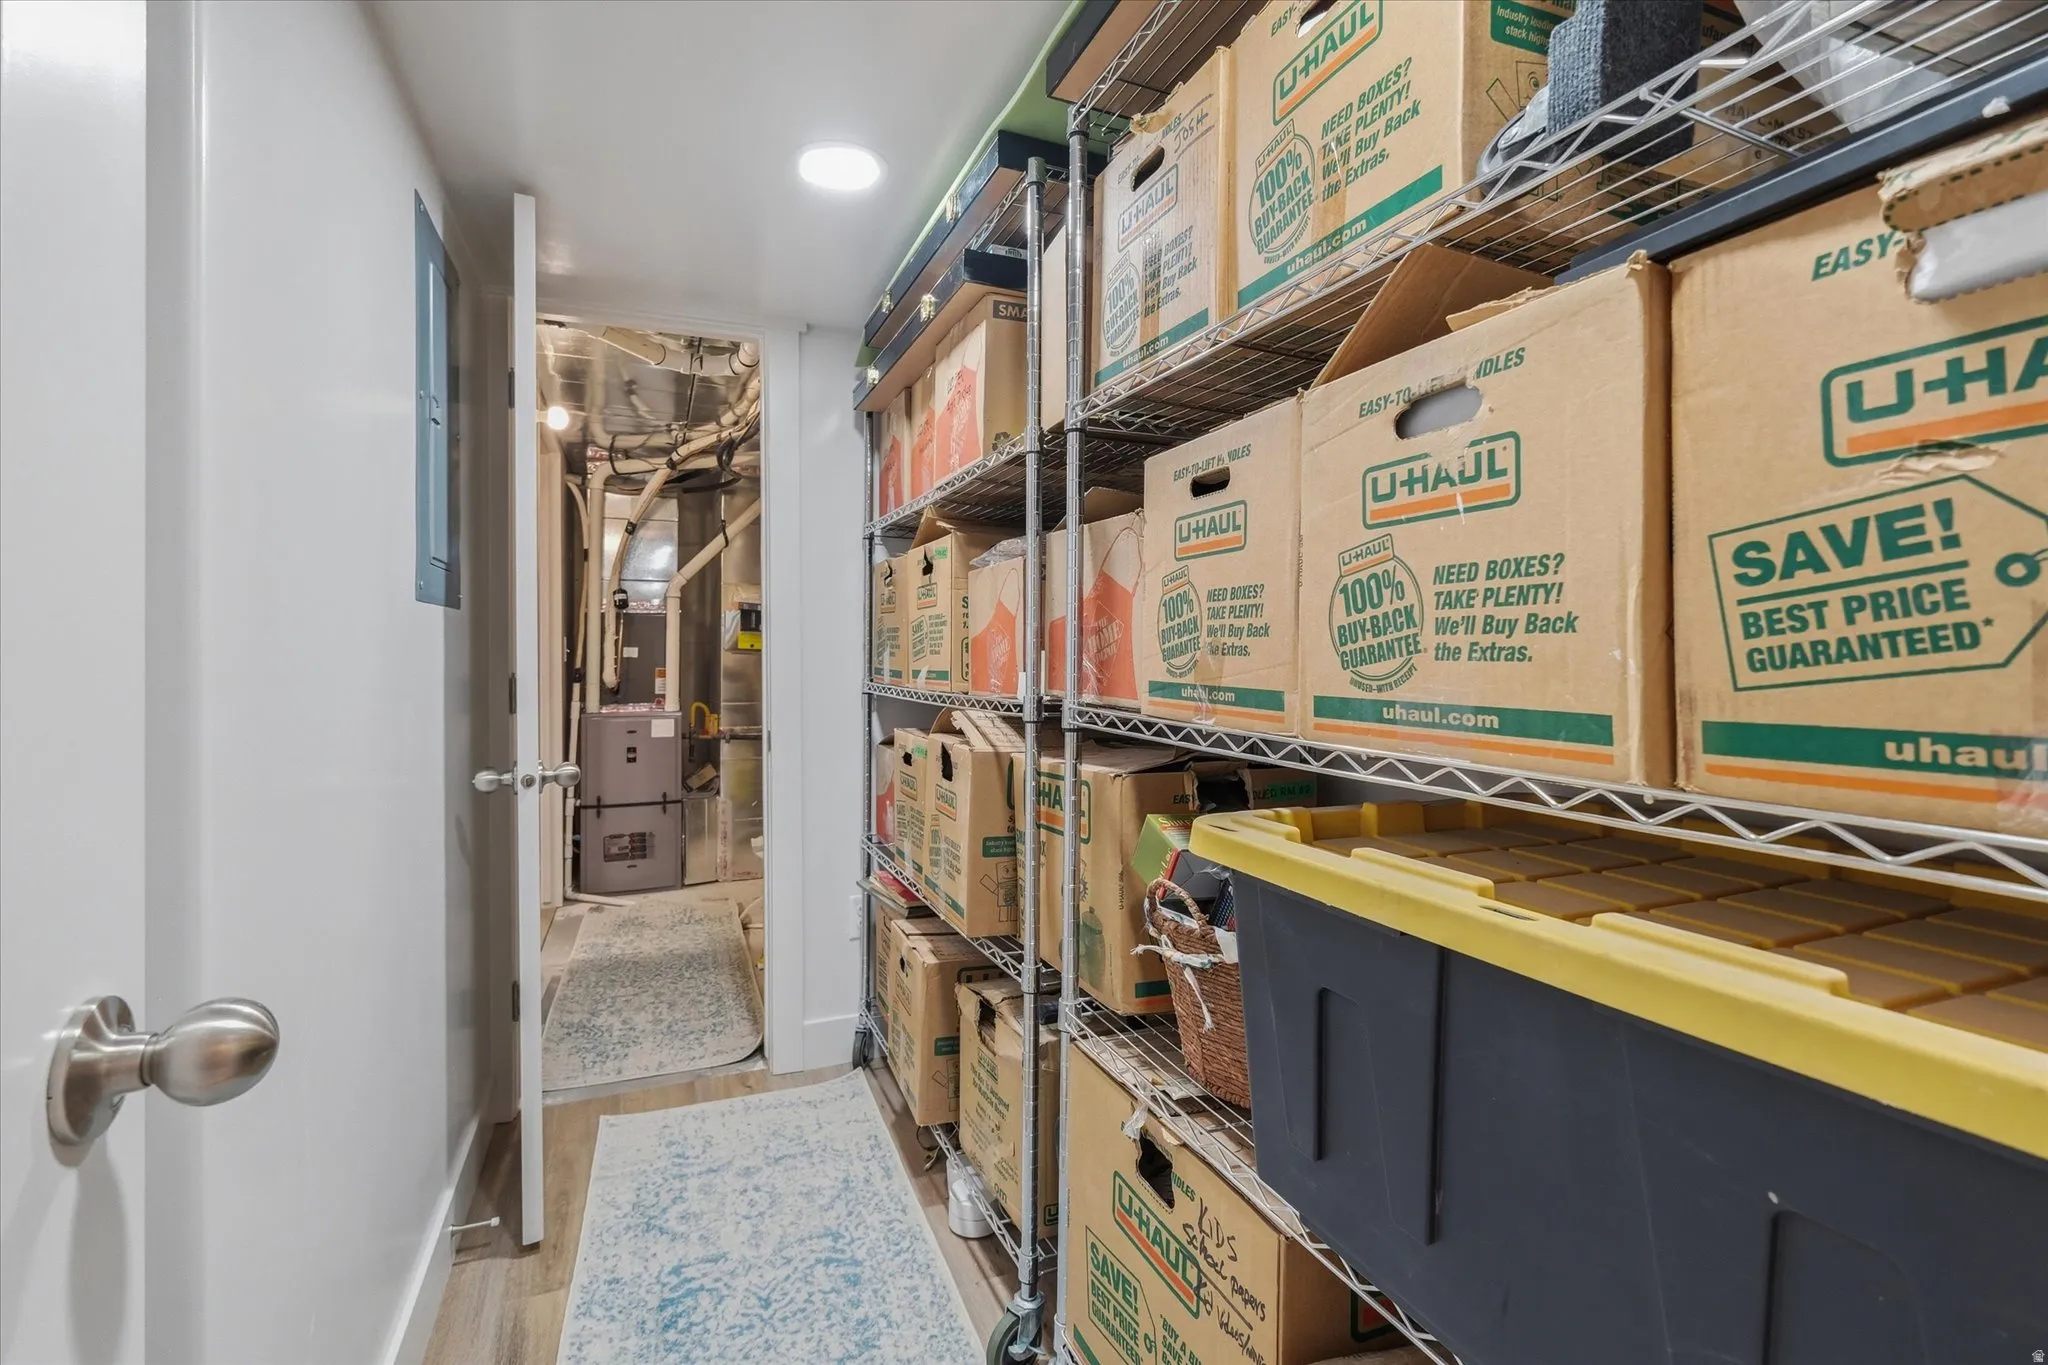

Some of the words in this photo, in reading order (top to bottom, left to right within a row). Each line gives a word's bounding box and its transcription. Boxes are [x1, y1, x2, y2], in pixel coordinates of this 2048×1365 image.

[1496, 5, 1529, 26] Industry
[1505, 25, 1527, 40] stack
[1279, 3, 1375, 100] U-HAUL
[1321, 102, 1353, 140] NEED
[1357, 56, 1412, 112] BOXES?
[1174, 108, 1209, 154] JOSH
[1322, 124, 1351, 160] TAKE
[1355, 80, 1411, 136] PLENTY!
[1354, 129, 1380, 157] Buy
[1384, 99, 1421, 138] Back
[1258, 123, 1292, 168] U-HAUL
[1256, 142, 1302, 209] 100%
[1322, 179, 1341, 202] the
[1345, 148, 1390, 187] Extras.
[1121, 177, 1174, 235] U-HAUL
[1255, 165, 1311, 237] BUY-BACK
[1257, 187, 1313, 255] GUARANTEE
[1162, 242, 1193, 274] PLENTY!
[1164, 225, 1194, 257] BOXES?
[1287, 219, 1367, 275] uhaul.com
[1107, 268, 1135, 313] 100%
[1162, 274, 1176, 290] Buy
[1178, 257, 1197, 280] Back
[999, 304, 1028, 320] SMA
[1105, 290, 1138, 334] BUY-BACK
[1106, 307, 1140, 349] GUARANTEE
[1144, 302, 1155, 318] the
[1123, 335, 1169, 368] uhaul.com
[1473, 346, 1526, 380] NDLES
[1173, 456, 1217, 482] EASY-TO-LIFT
[1371, 447, 1509, 504] U-HAUL
[1178, 510, 1242, 543] U-HAUL
[1732, 497, 1962, 588] SAVE!
[1342, 539, 1390, 567] U-HAUL
[1433, 562, 1479, 585] NEED
[1485, 552, 1565, 581] BOXES?
[1162, 587, 1194, 624] 100%
[1207, 589, 1228, 603] NEED
[1230, 583, 1265, 601] BOXES?
[1338, 564, 1406, 618] 100%
[1434, 589, 1477, 611] TAKE
[1482, 582, 1564, 608] PLENTY!
[1739, 600, 1829, 641] BEST
[1841, 577, 1971, 626] PRICE
[1161, 615, 1199, 645] BUY-BACK
[1207, 606, 1226, 620] TAKE
[1228, 603, 1264, 619] PLENTY!
[1337, 603, 1418, 647] BUY-BACK
[1434, 615, 1476, 636] We'll
[1482, 614, 1519, 639] Buy
[1525, 611, 1579, 634] Back
[1162, 635, 1201, 662] GUARANTEE
[1207, 623, 1226, 638] We'll
[1228, 624, 1245, 640] Buy
[1247, 623, 1271, 638] Back
[1340, 632, 1422, 671] GUARANTEE
[1434, 643, 1462, 662] the
[1467, 642, 1533, 662] Extras.
[1181, 686, 1235, 702] uhaul.com
[1382, 704, 1499, 729] uhaul.com
[1118, 1182, 1193, 1289] U-HAUL
[1198, 1196, 1237, 1262] KIDS
[1090, 1241, 1139, 1316] SAVE!
[1091, 1279, 1110, 1314] BEST
[1113, 1303, 1139, 1348] PRICE
[1180, 1340, 1186, 1357] A
